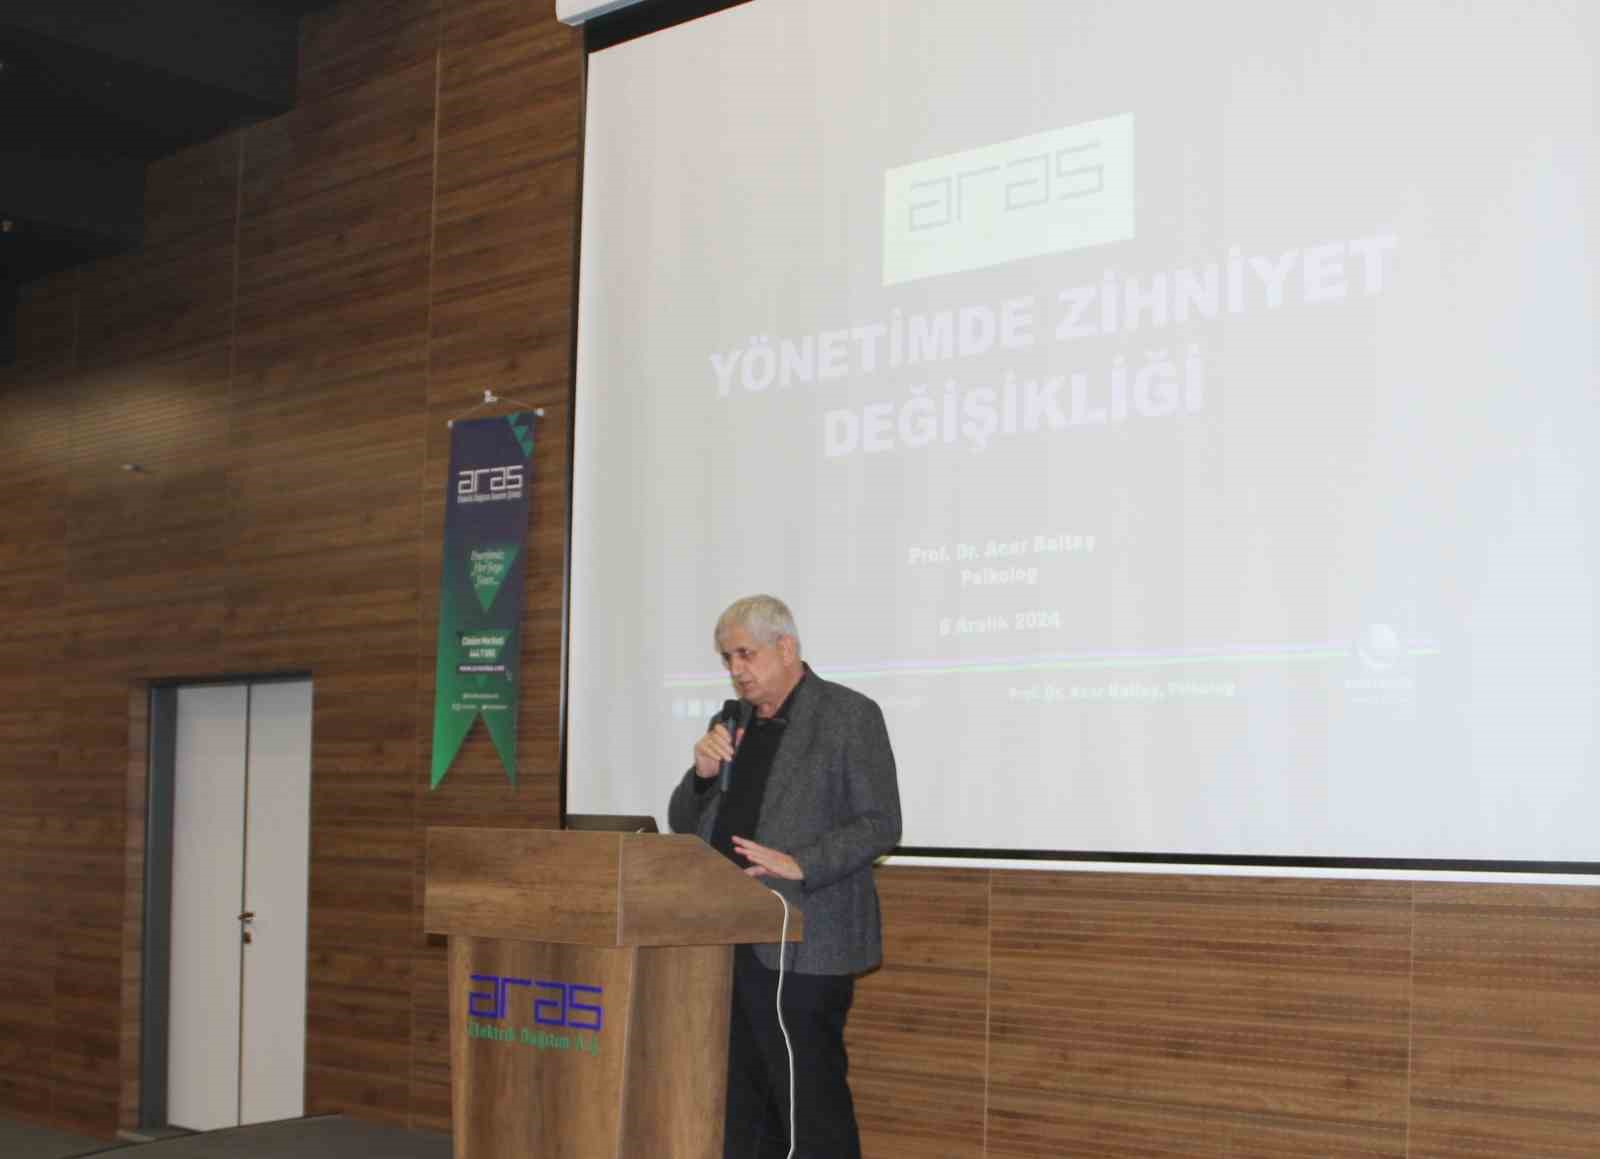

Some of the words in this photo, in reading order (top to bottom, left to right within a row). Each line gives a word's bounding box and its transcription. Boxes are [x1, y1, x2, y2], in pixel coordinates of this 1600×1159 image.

[907, 138, 1106, 233] aras
[708, 298, 1036, 400] YÖNETİMDE
[1056, 234, 1399, 342] ZİHNİYET
[824, 344, 1206, 458] DEĞİŞİKLİĞİ
[458, 465, 524, 493] aras
[468, 974, 603, 1032] aras
